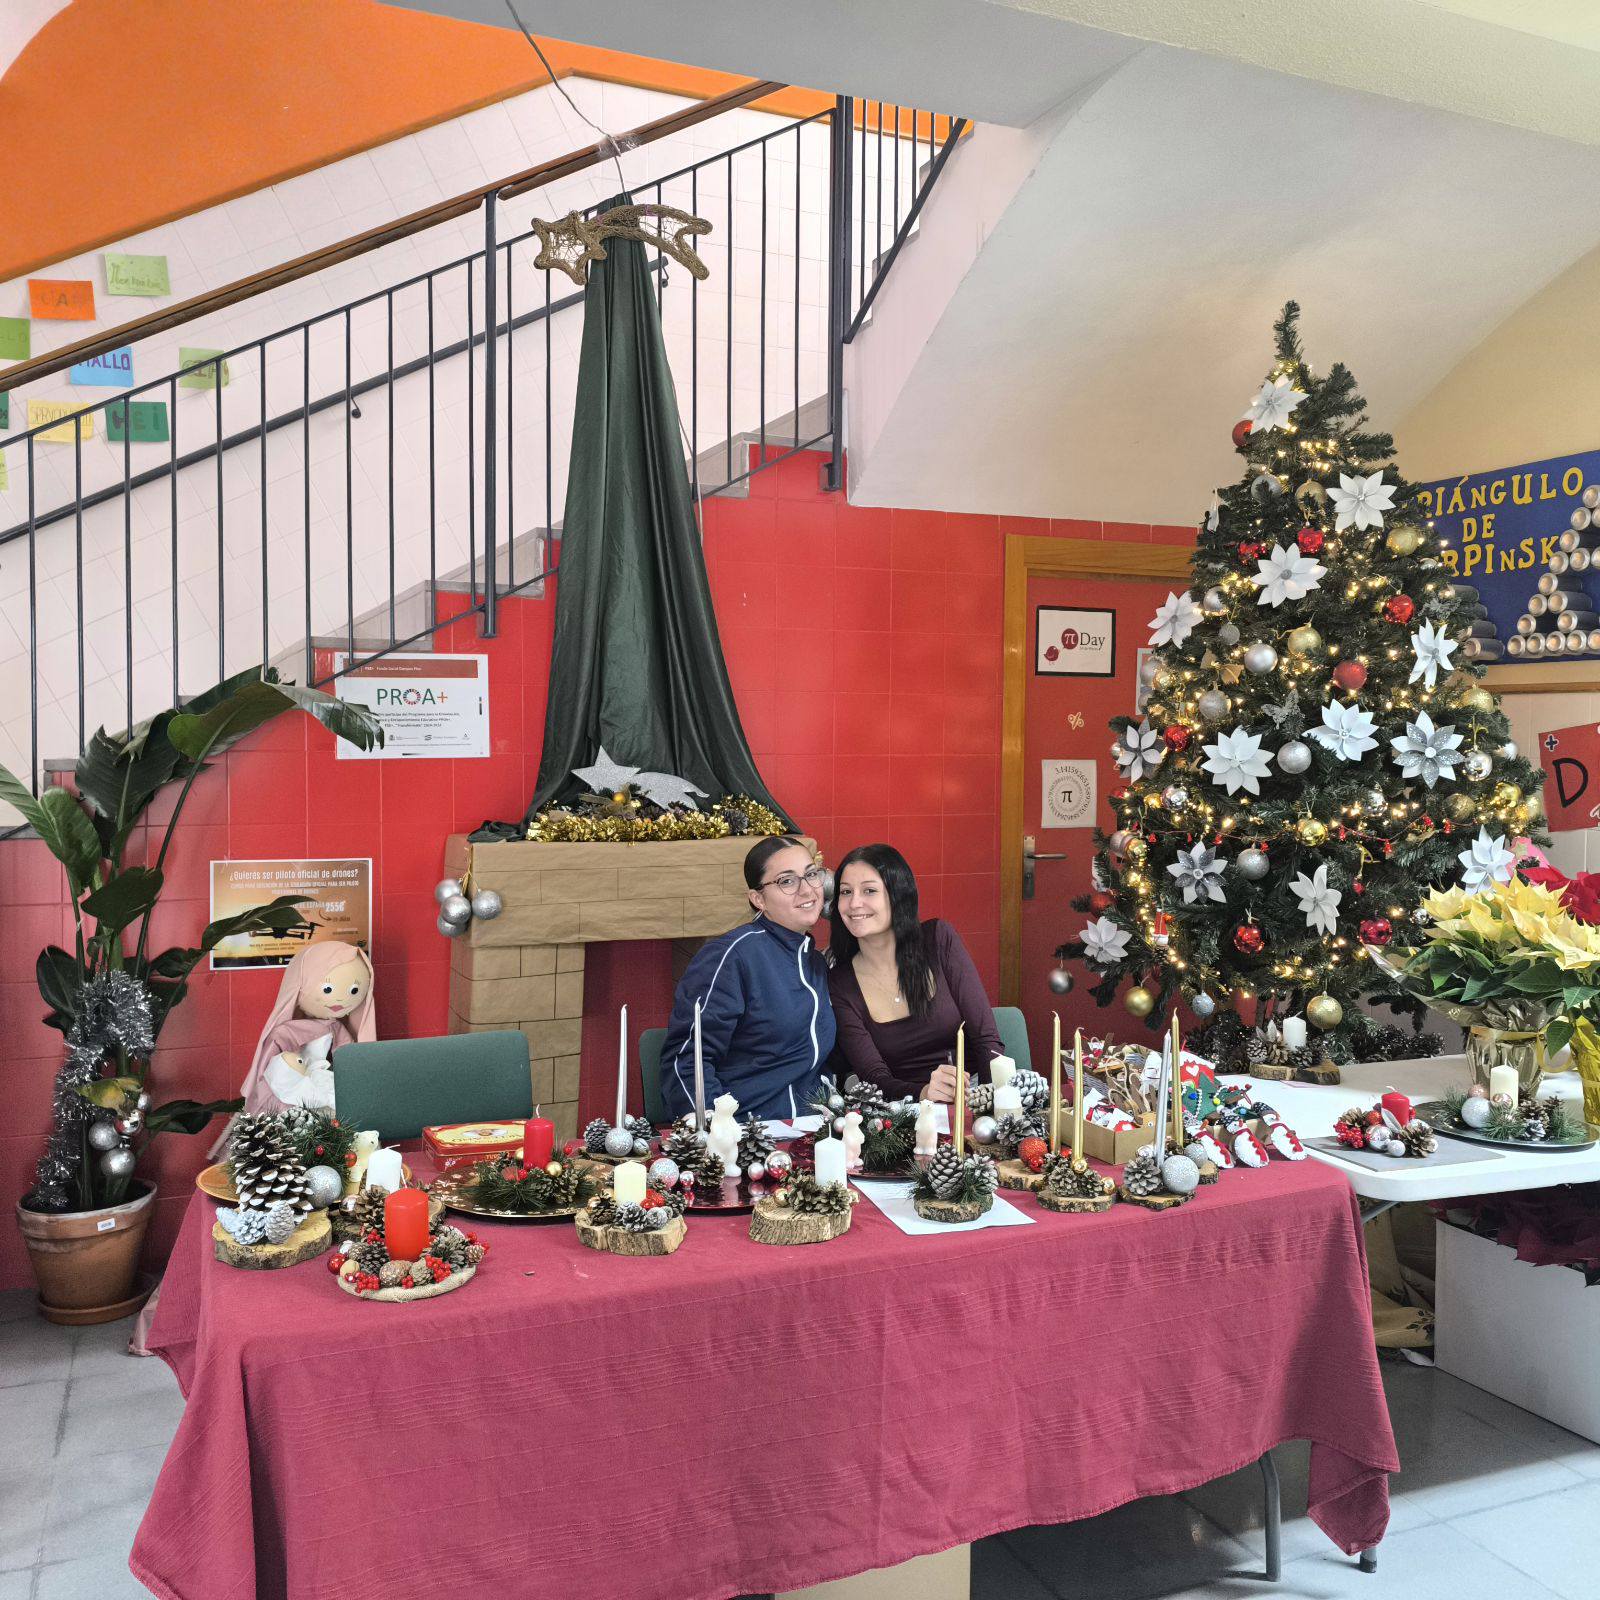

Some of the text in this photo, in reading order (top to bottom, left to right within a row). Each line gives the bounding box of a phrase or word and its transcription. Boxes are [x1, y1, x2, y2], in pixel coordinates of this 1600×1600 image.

[1417, 467, 1584, 518] RIÁNGULO
[1462, 513, 1496, 543] DE
[1443, 535, 1560, 577] RPINSK
[1079, 632, 1105, 650] Day
[377, 688, 448, 705] PROA+
[230, 868, 359, 881] ¿Quieres ser piloto oficial de drones?
